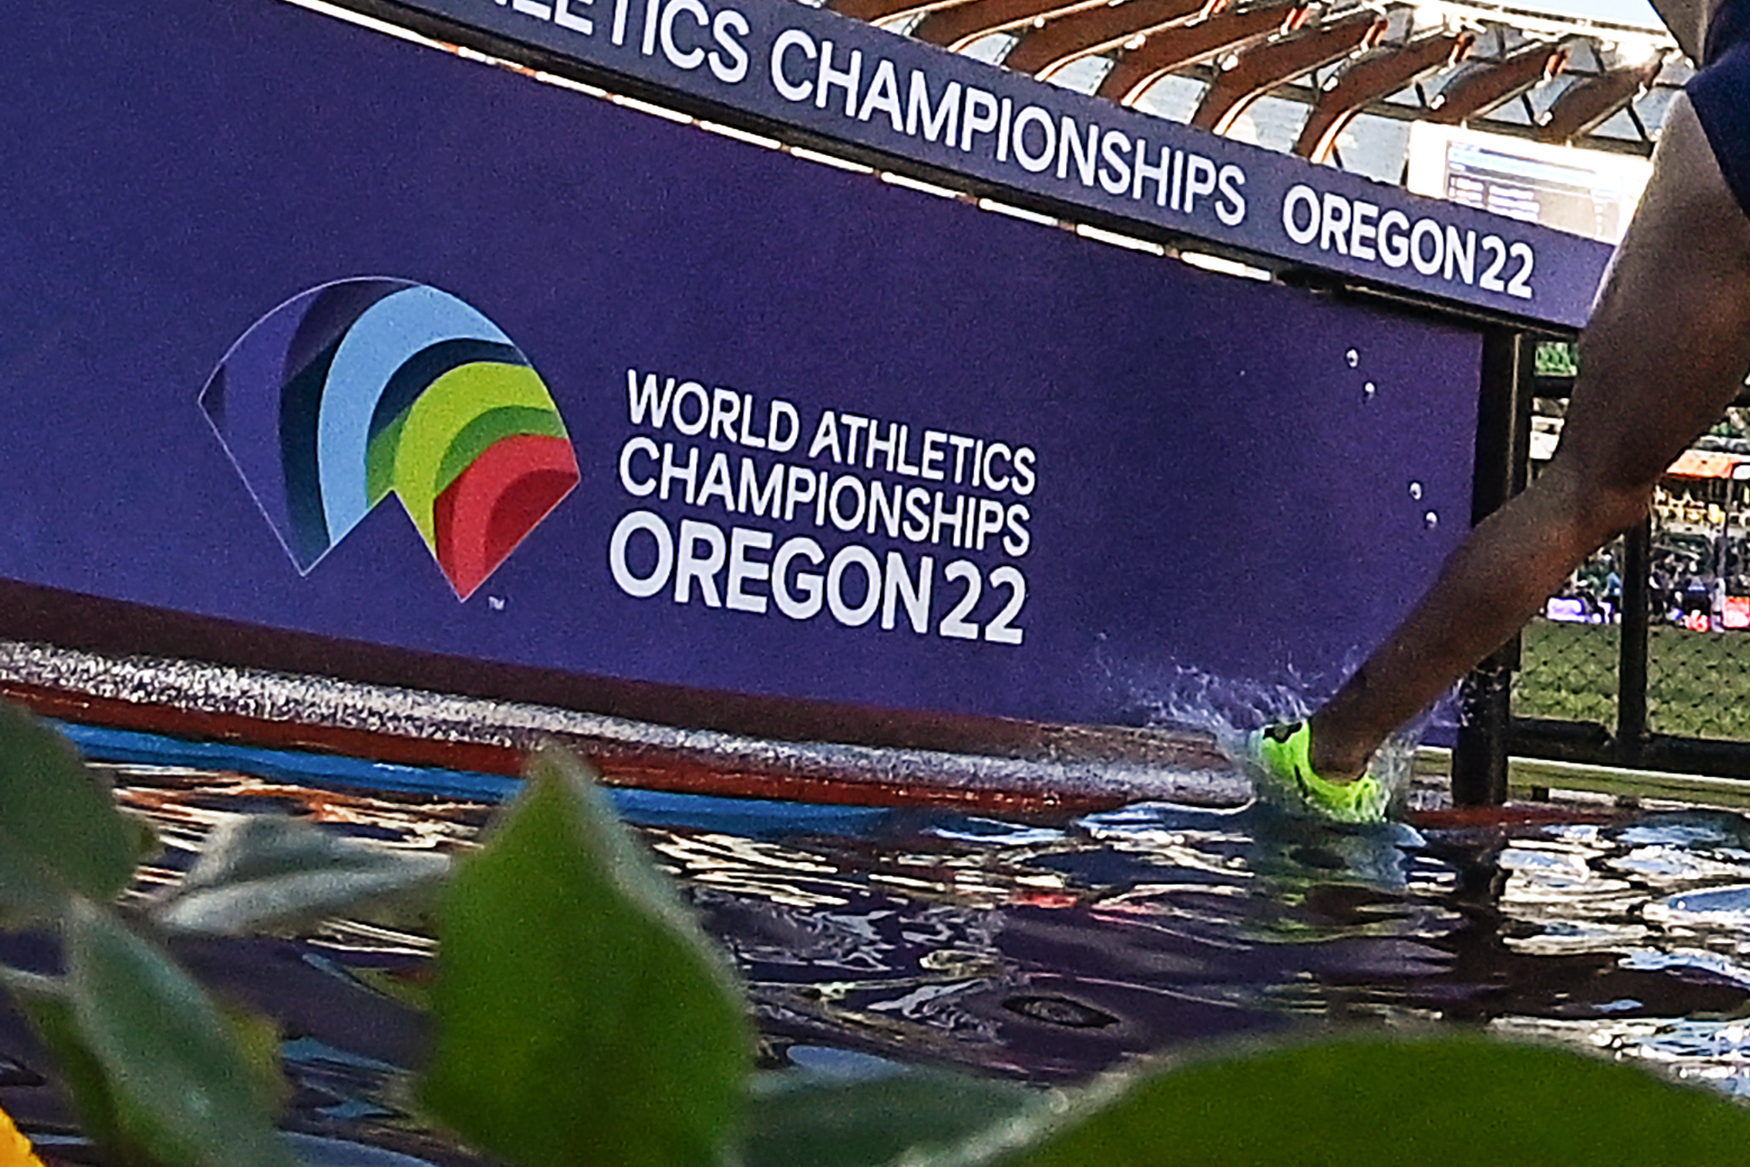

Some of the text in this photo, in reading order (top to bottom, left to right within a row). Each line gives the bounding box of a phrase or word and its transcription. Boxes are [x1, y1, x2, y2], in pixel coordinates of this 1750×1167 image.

[770, 31, 1247, 225] CHAMPIONSHIPS
[1282, 184, 1535, 299] OREGON22
[619, 437, 1030, 557] CHAMPIONSHIPS
[627, 369, 1036, 495] WORLD ATHLETICS
[610, 511, 1027, 645] OREGON22
